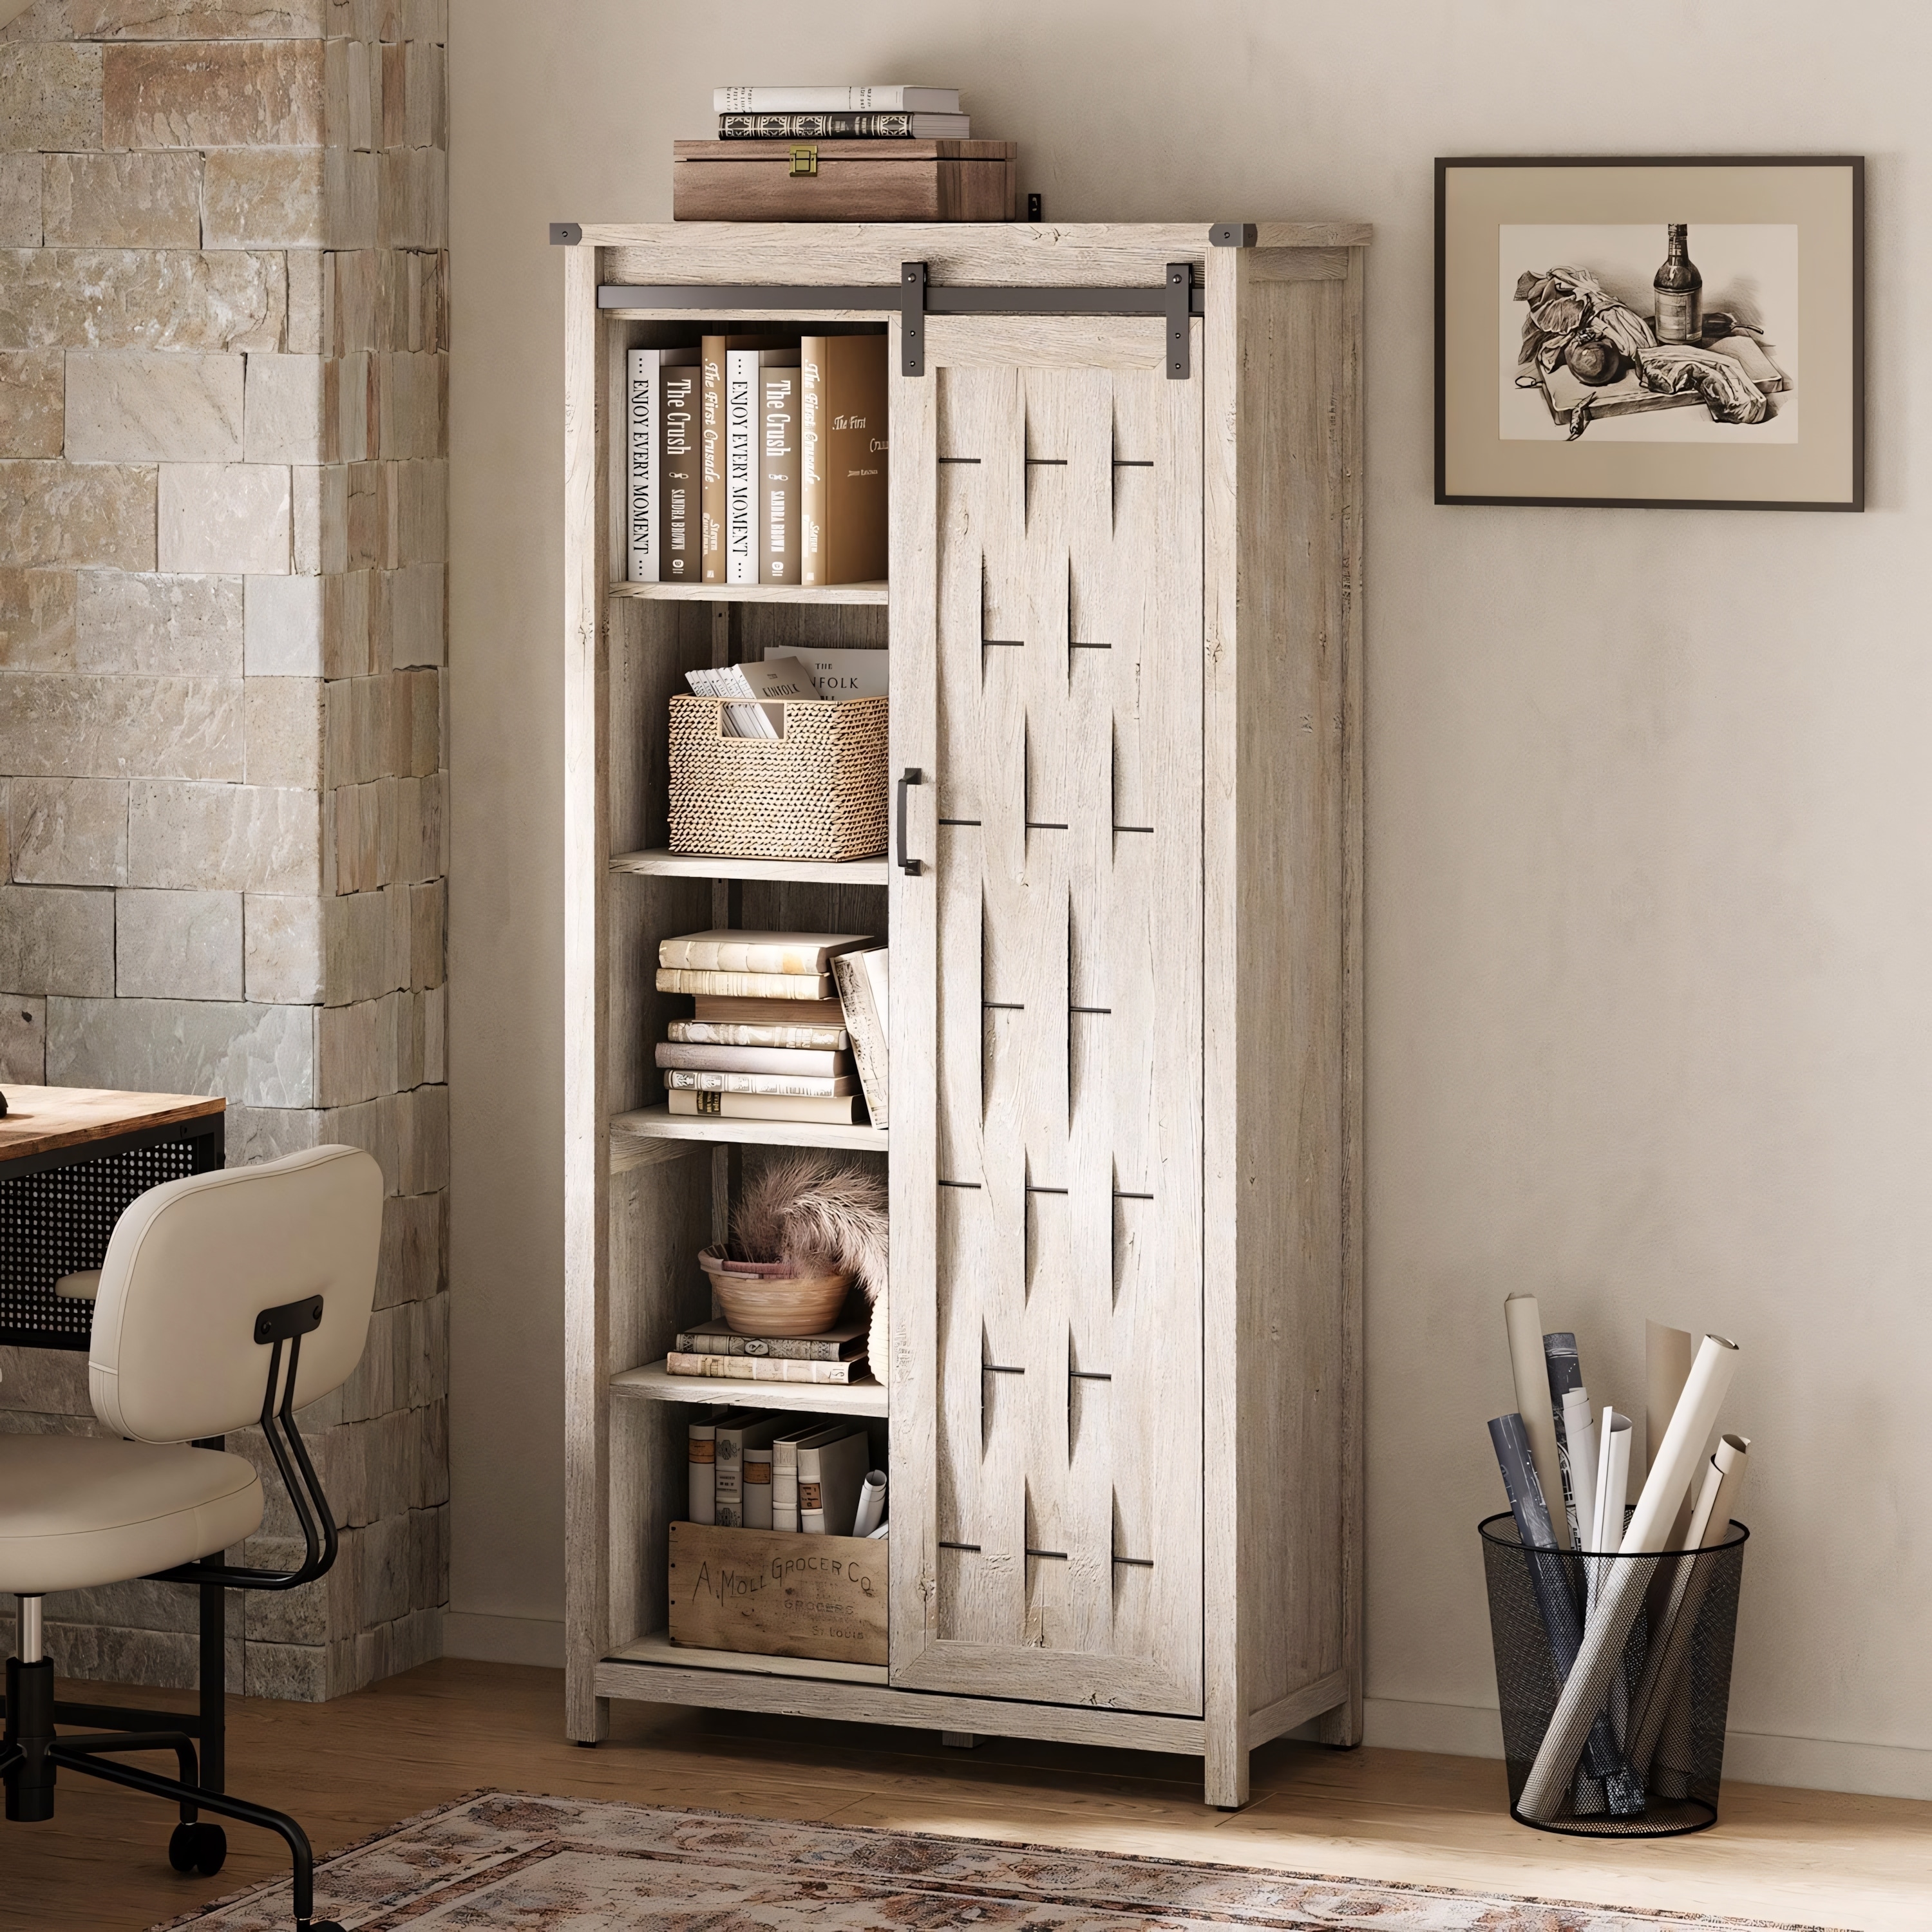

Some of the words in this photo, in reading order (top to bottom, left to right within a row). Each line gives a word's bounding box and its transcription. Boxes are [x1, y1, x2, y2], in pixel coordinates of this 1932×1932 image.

[667, 379, 692, 408] The
[705, 362, 721, 388] The
[766, 380, 791, 409] The
[631, 379, 649, 428] ENJOY
[730, 381, 748, 429] ENJOY
[633, 431, 649, 480] EVERY
[667, 412, 692, 455] Crush
[703, 429, 721, 483] Crusade
[732, 433, 748, 482] EVERY
[766, 413, 791, 457] Crush
[633, 484, 649, 554] MOMENT
[732, 487, 748, 556] MOMENT
